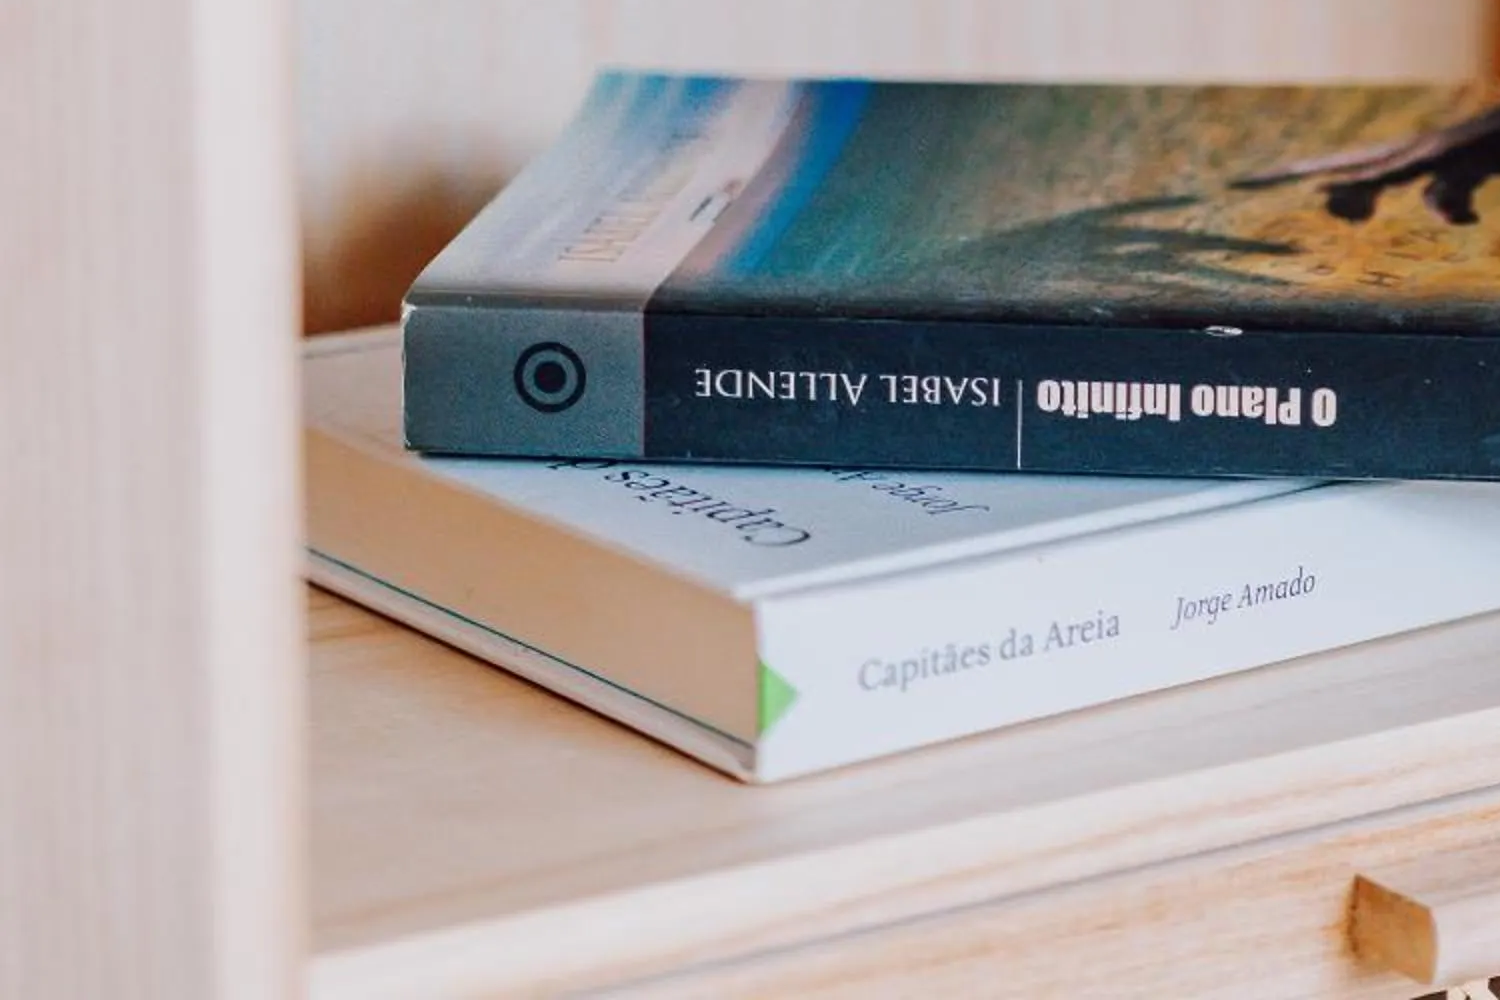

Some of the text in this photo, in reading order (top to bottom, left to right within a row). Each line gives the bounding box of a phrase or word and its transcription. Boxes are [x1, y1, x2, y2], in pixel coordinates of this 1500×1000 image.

[694, 368, 1000, 407] ISABEL ALLENDE
[1036, 379, 1337, 427] O Plano Infinito
[604, 469, 811, 547] Capitães
[872, 482, 990, 515] Jorge
[1170, 565, 1317, 630] Jorge Amado
[857, 609, 1121, 692] Capitães da Areia
